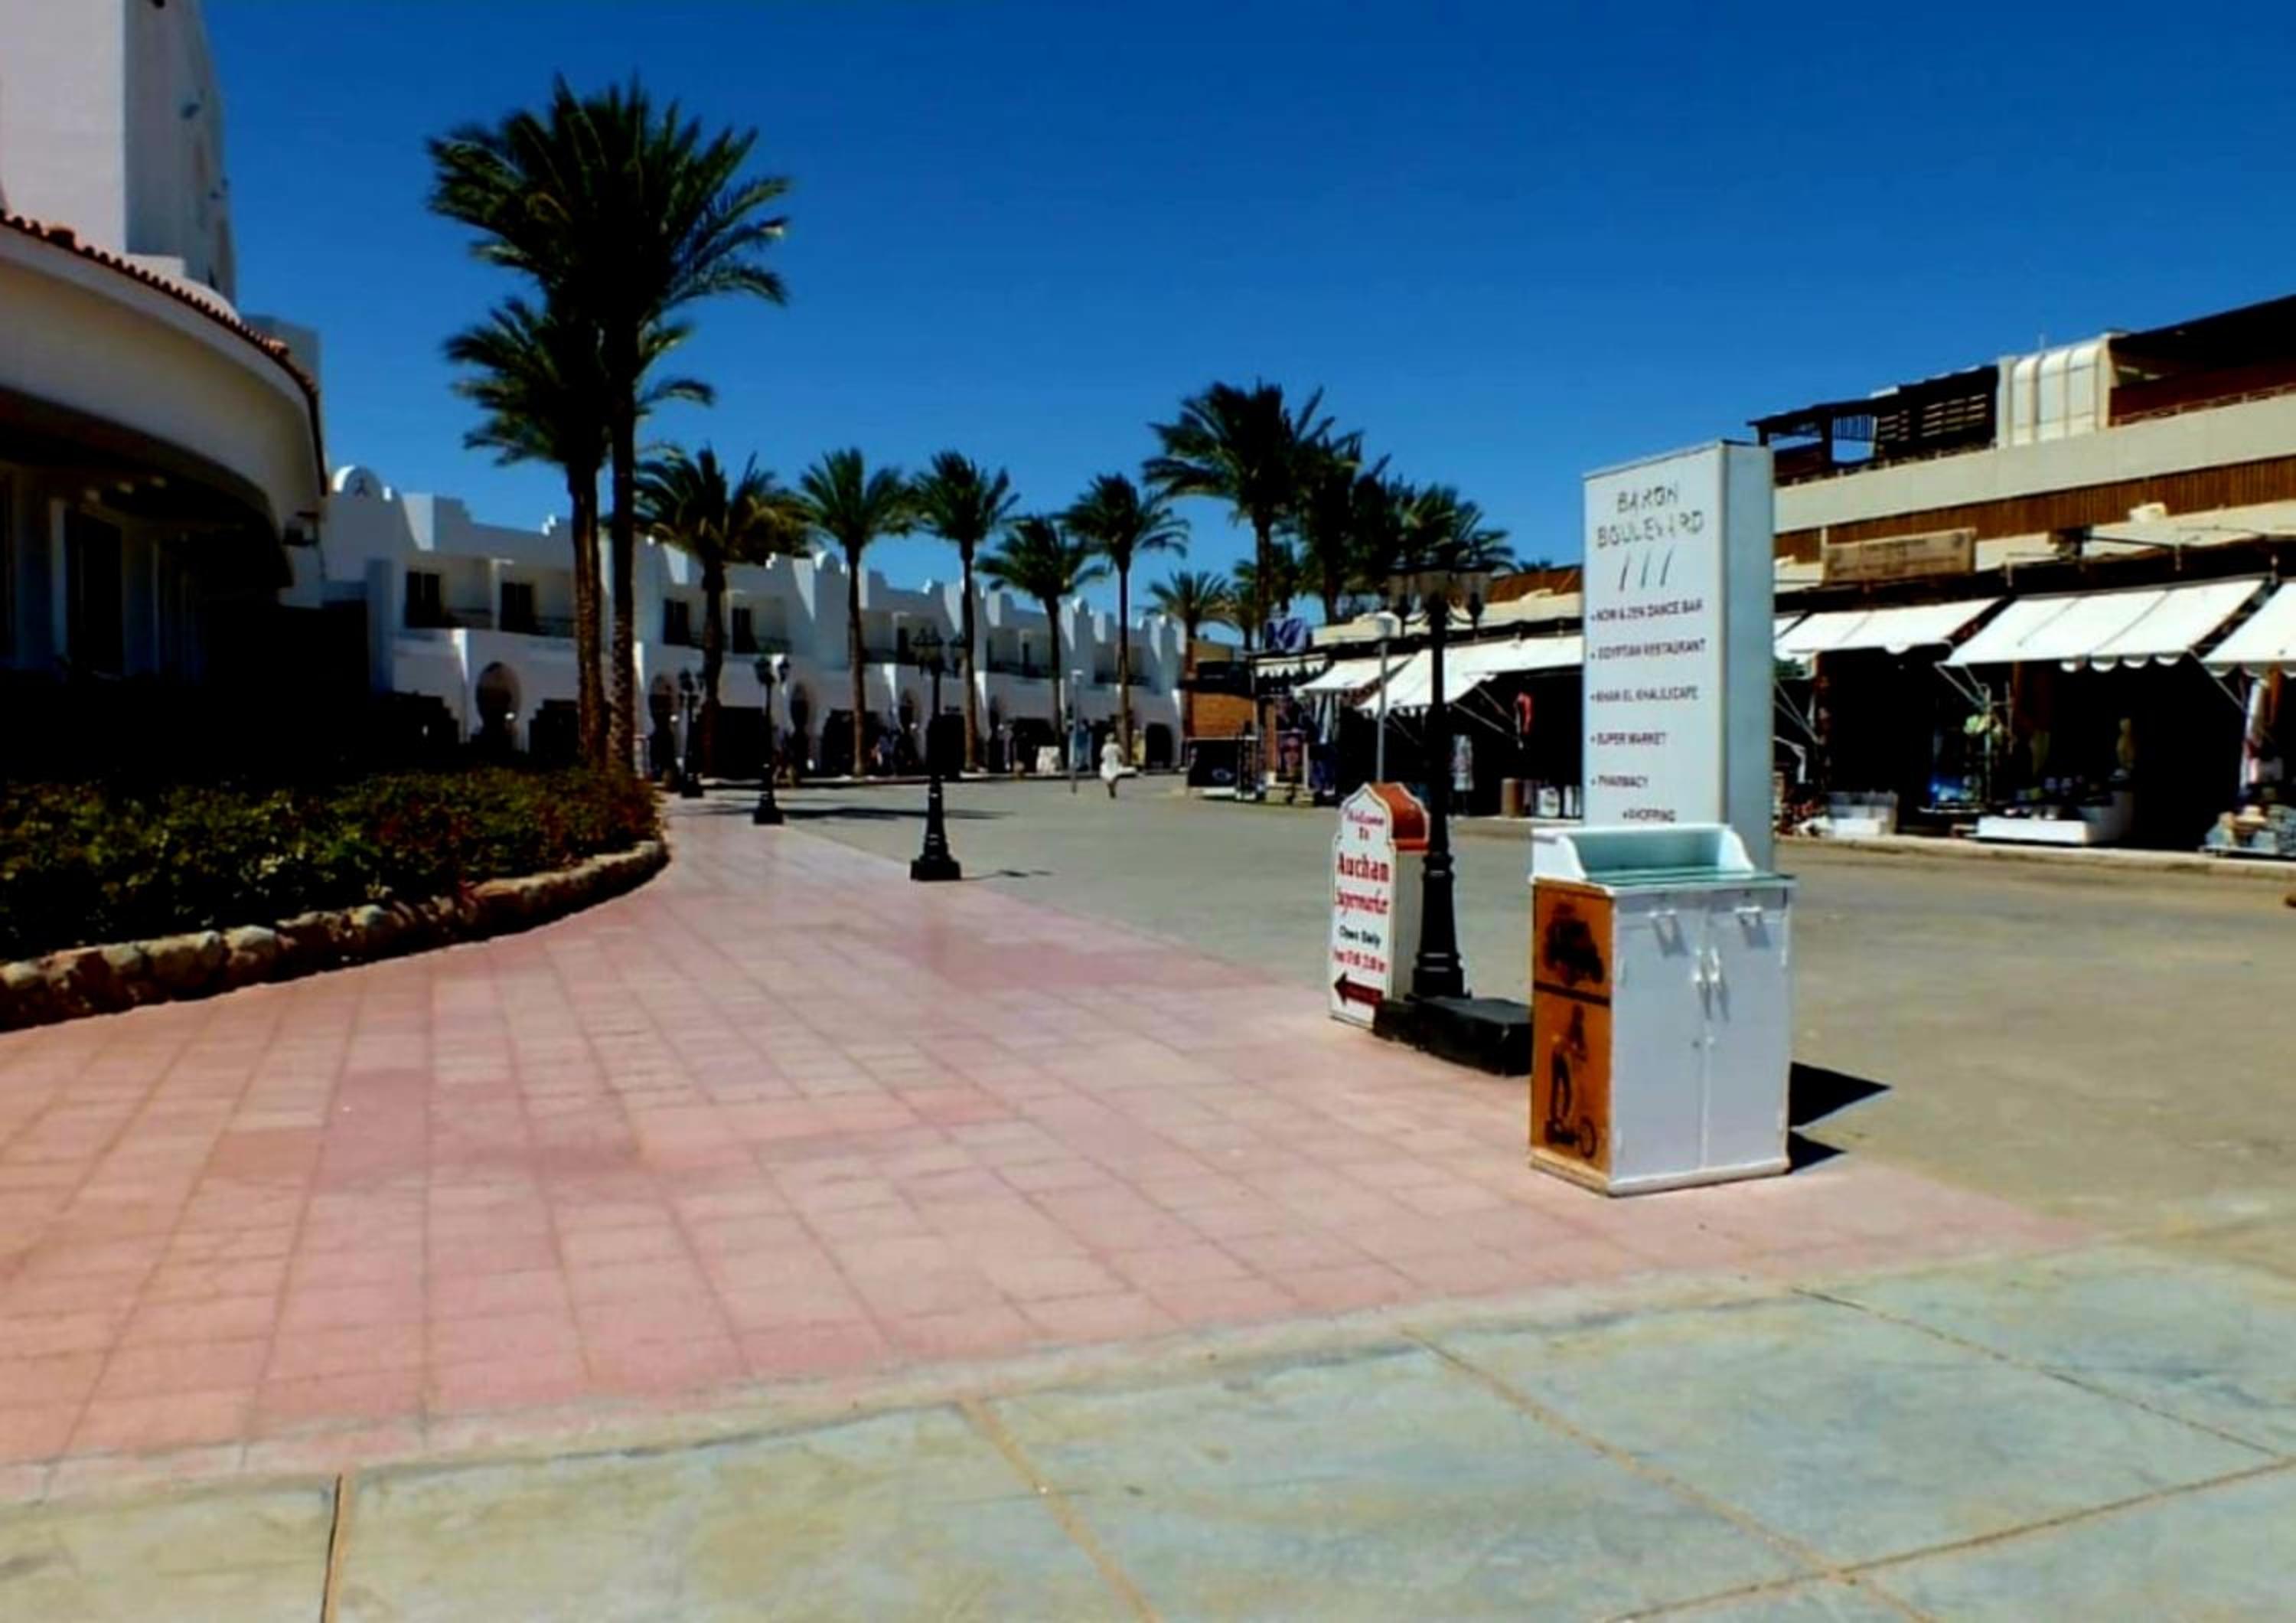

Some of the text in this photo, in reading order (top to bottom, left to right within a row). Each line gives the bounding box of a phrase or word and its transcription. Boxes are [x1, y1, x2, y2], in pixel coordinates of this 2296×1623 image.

[1648, 601, 1678, 617] DANCE
[1682, 598, 1703, 614] BAR
[1599, 638, 1706, 660] EGYPTIAN RESTAURANT
[1597, 733, 1666, 746] SUPER MARKET
[1598, 775, 1649, 788] PHARMACY
[1338, 852, 1389, 882] Auchan
